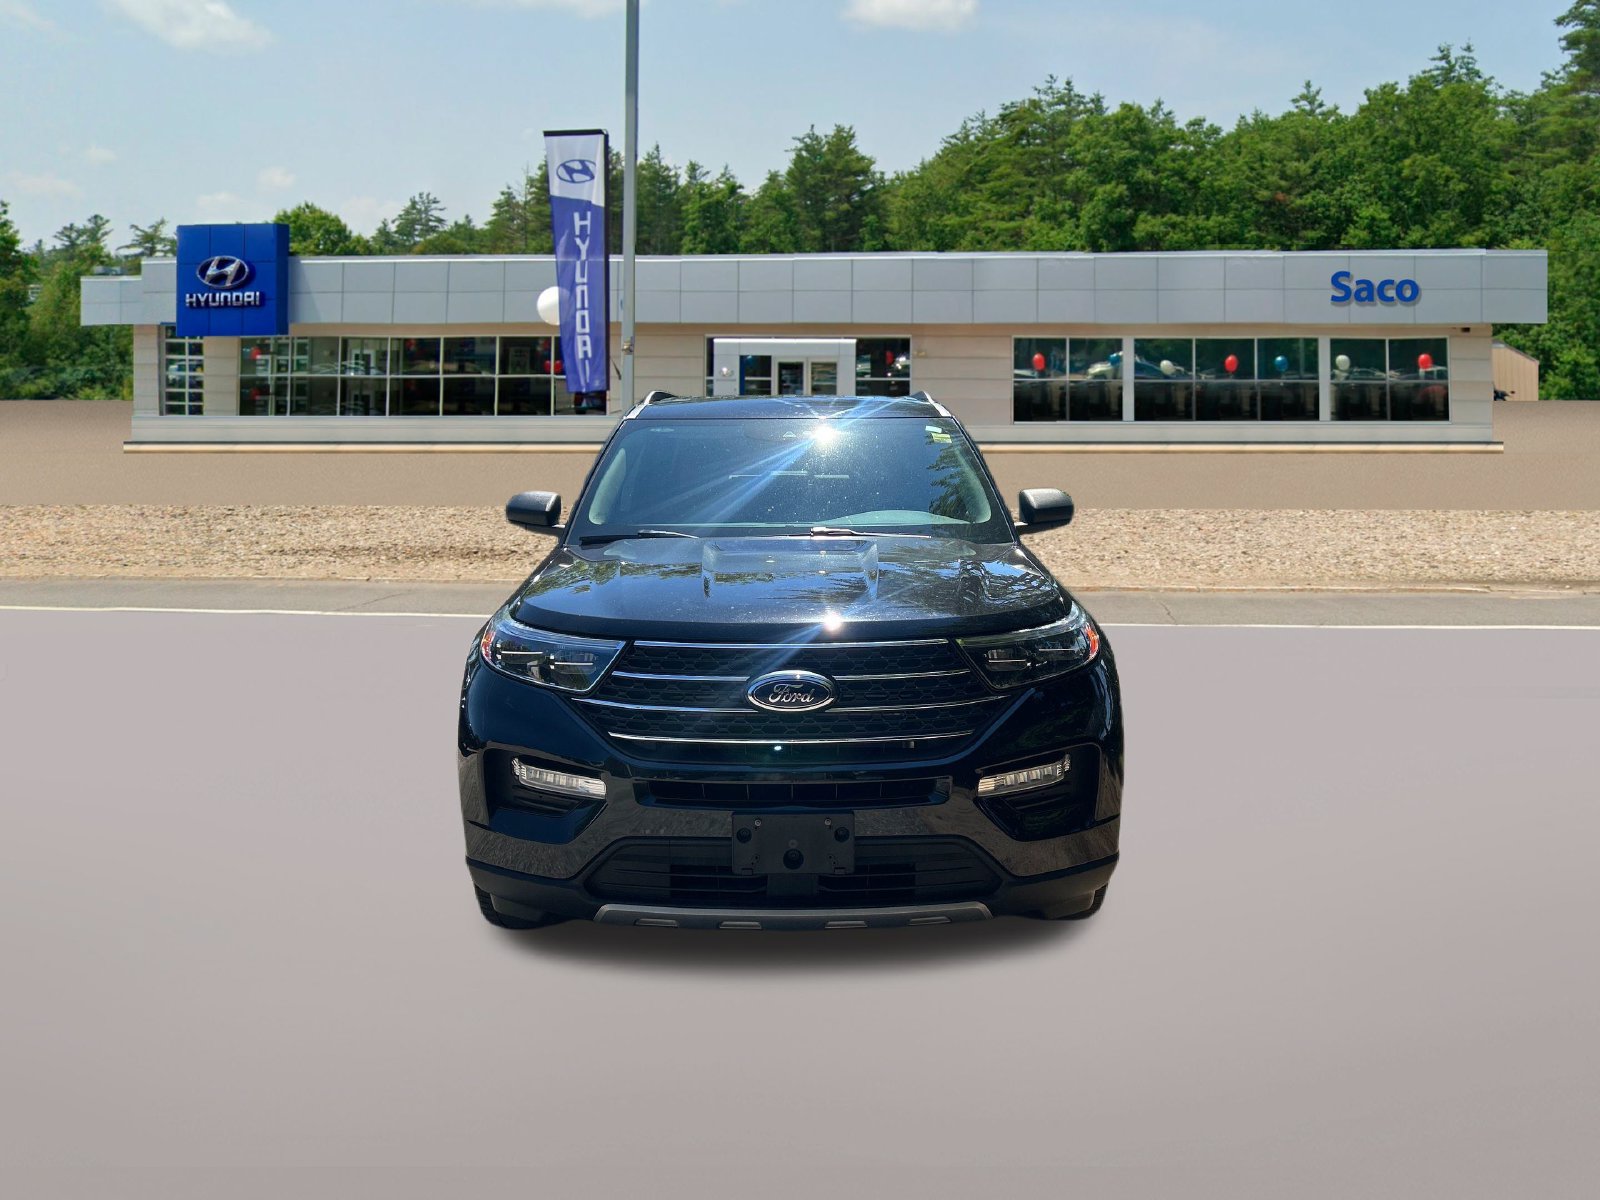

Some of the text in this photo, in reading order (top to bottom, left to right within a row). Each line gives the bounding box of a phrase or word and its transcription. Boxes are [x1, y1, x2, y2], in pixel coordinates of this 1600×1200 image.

[185, 291, 260, 307] HYUNDAI
[573, 211, 592, 384] HYUNDAI
[1330, 270, 1420, 303] Saco
[768, 683, 815, 703] Ford
